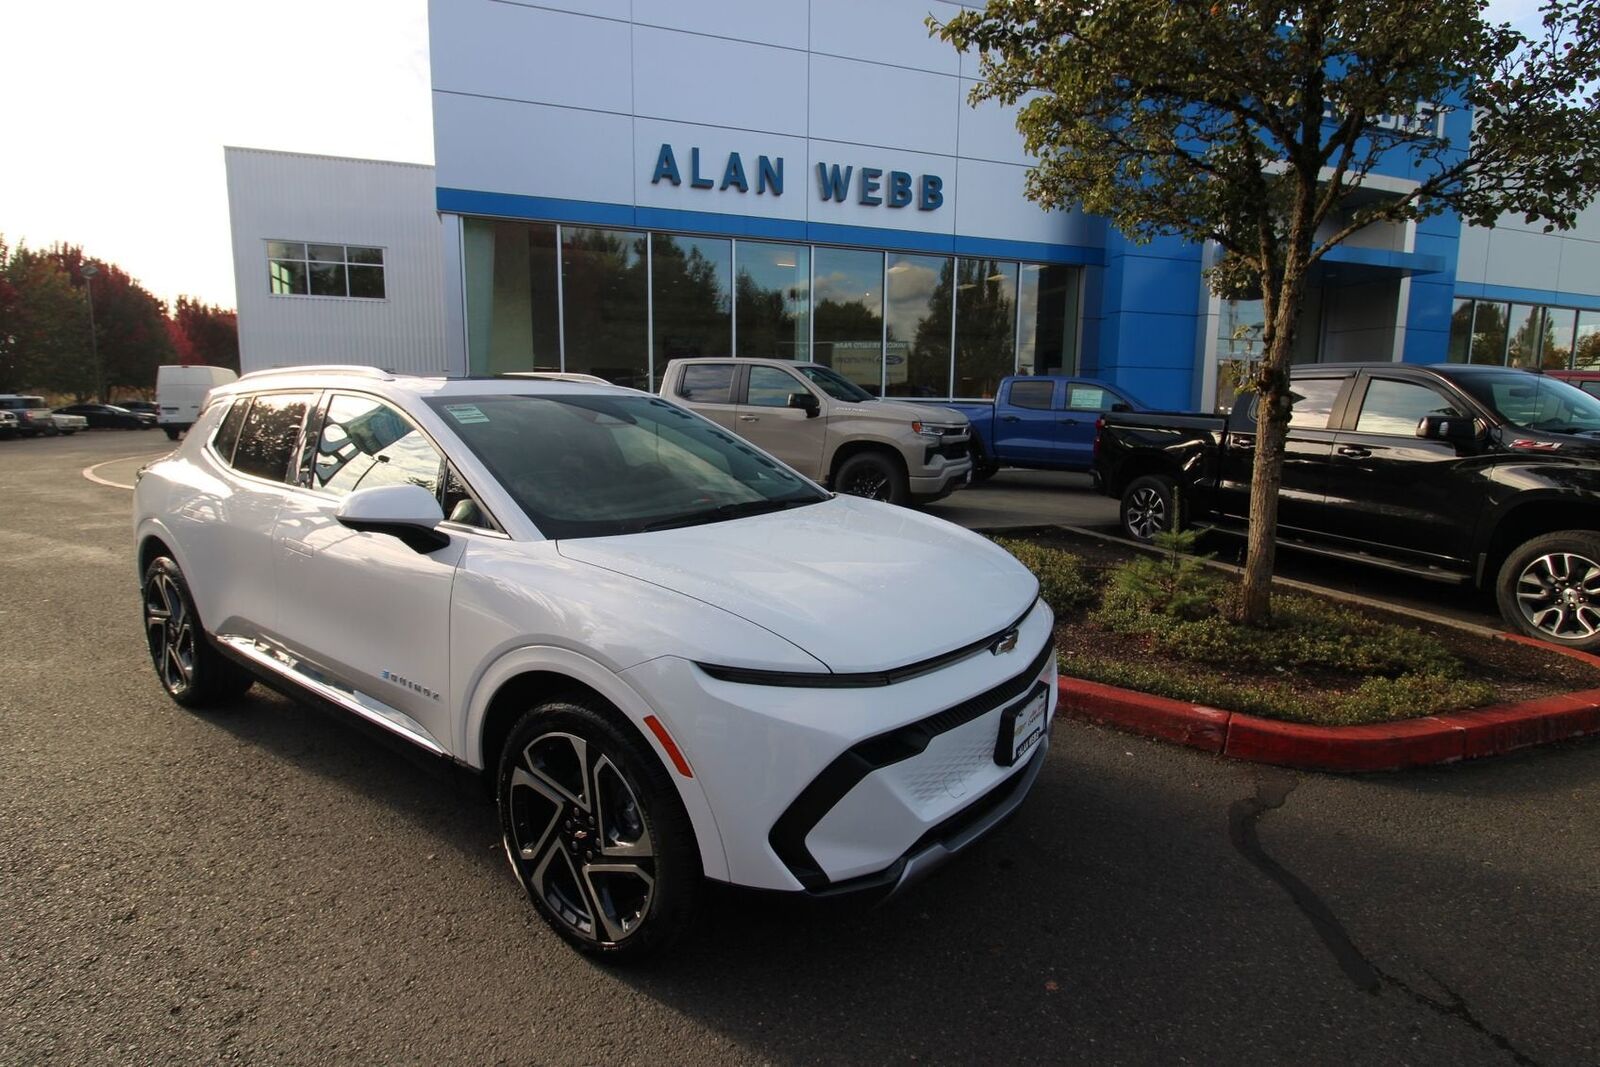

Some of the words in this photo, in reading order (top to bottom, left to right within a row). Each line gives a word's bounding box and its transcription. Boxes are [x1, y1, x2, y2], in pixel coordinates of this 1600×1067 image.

[652, 143, 784, 196] ALAN
[817, 162, 944, 211] WEBB
[1509, 438, 1563, 452] Z71
